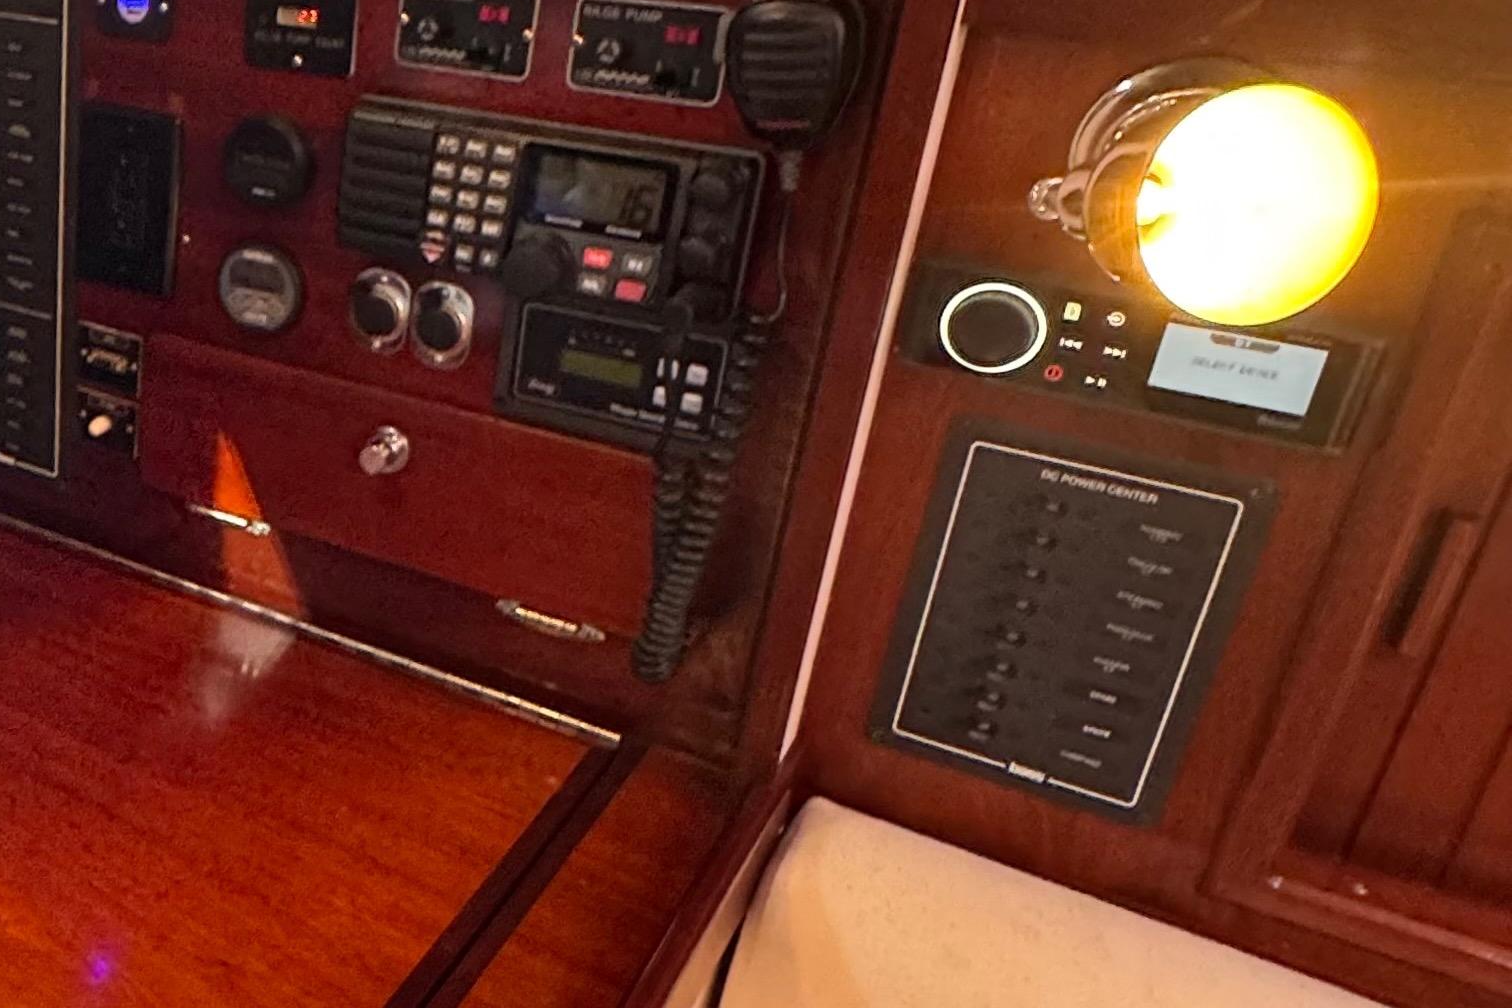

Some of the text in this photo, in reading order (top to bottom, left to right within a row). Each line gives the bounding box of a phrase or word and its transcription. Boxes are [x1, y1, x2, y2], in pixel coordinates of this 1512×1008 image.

[624, 8, 664, 24] PUMP
[1059, 472, 1106, 494] POWER
[1106, 483, 1160, 505] CENTER
